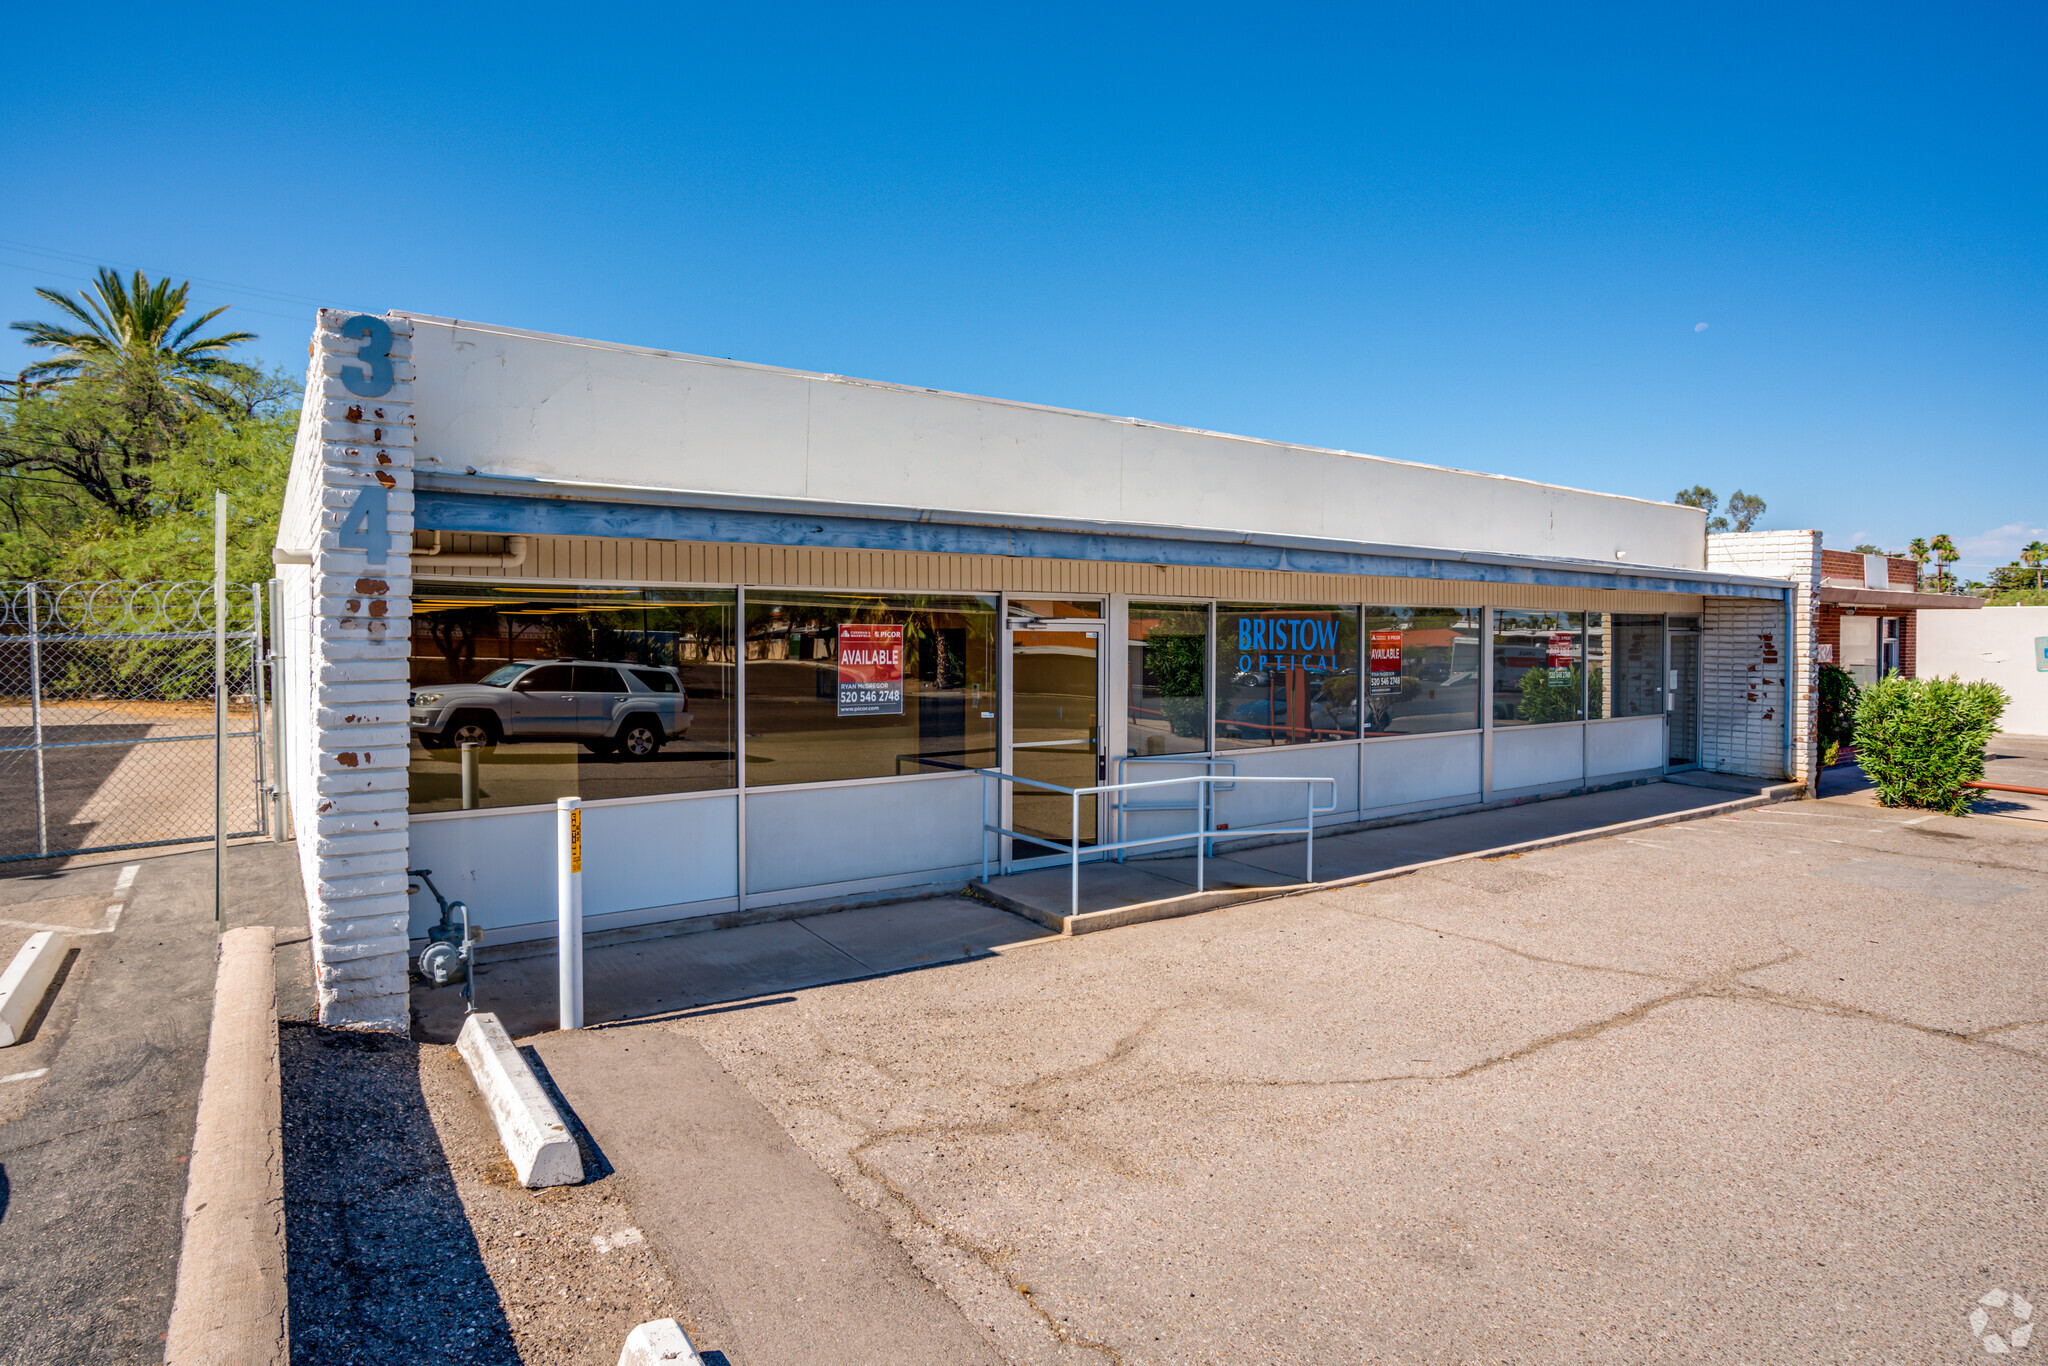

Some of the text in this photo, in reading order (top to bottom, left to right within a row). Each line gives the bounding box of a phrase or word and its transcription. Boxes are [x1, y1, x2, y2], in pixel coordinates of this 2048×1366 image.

[338, 313, 393, 565] 3 4
[1238, 618, 1339, 651] BRISTOW
[841, 649, 898, 665] AVAILABLE
[1371, 648, 1400, 659] AVAILABLE
[1239, 654, 1339, 672] OPTICAL
[1371, 677, 1380, 686] 520
[840, 690, 900, 703] 520 546 2748
